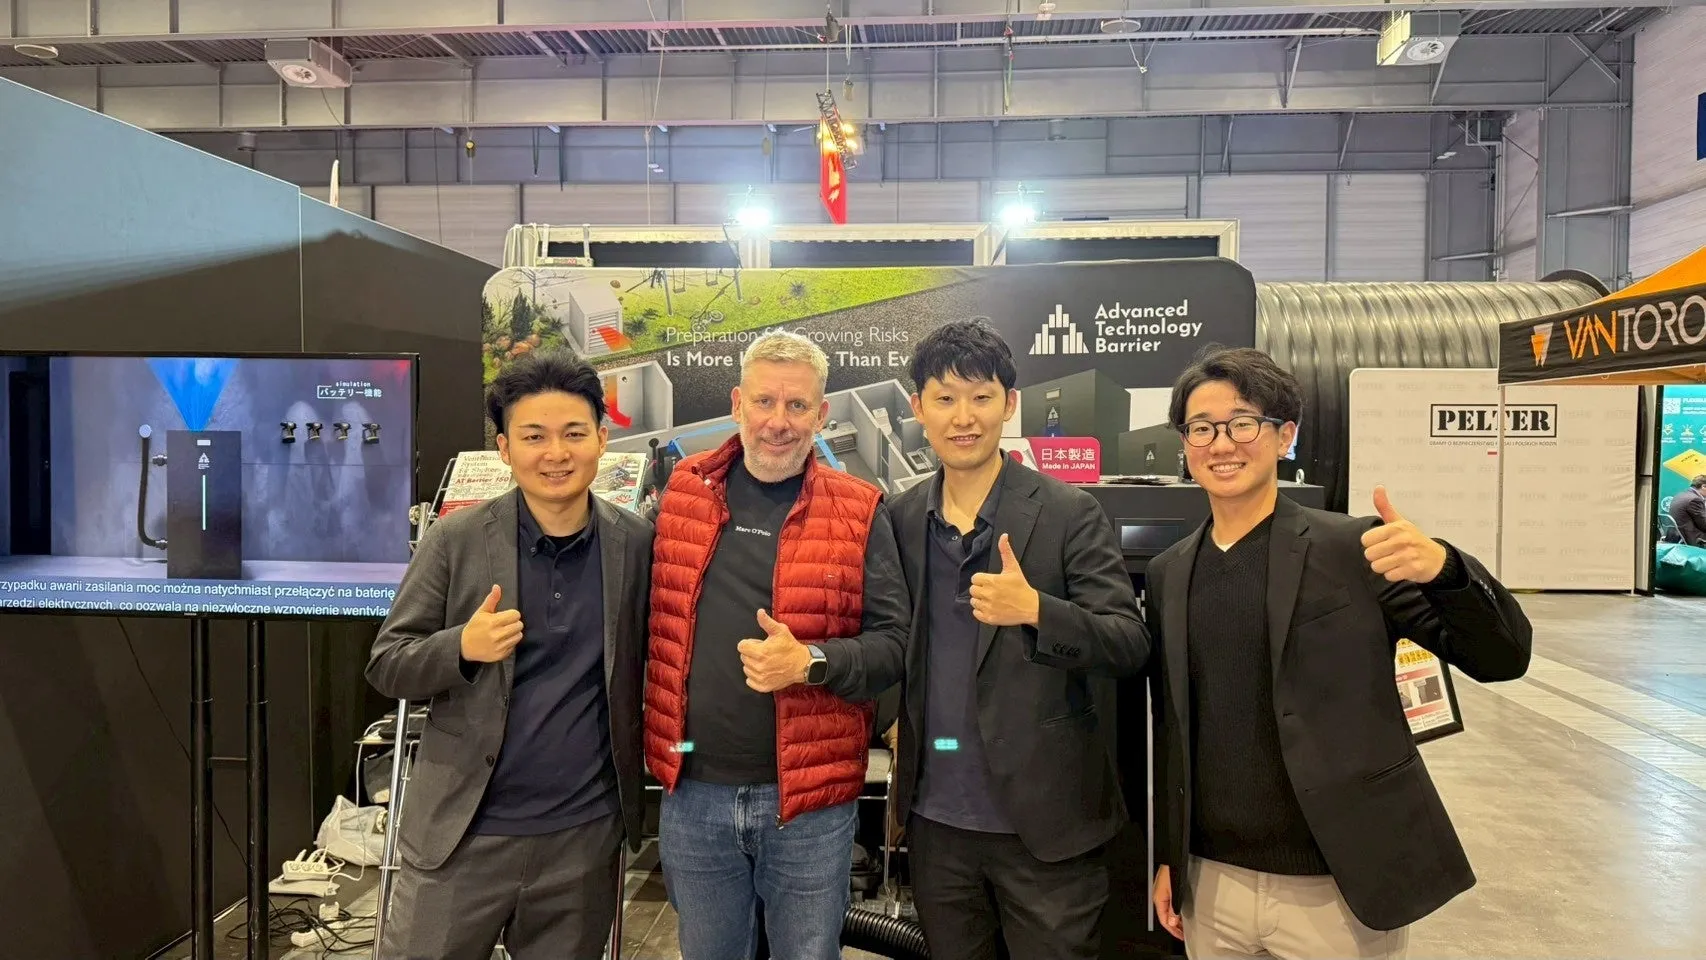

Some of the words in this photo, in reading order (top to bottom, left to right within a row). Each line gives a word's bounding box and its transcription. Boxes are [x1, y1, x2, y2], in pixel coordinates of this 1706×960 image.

[1095, 299, 1188, 319] Advanced
[665, 327, 757, 346] Preparation
[869, 327, 909, 343] Risks
[1095, 317, 1202, 337] Technology
[1563, 295, 1706, 359] VANTORO
[1096, 338, 1161, 353] Barrier
[667, 351, 680, 366] Is
[686, 351, 733, 366] More
[836, 351, 882, 366] Than
[888, 351, 910, 366] Ev
[1041, 448, 1096, 461] 日本製造
[50, 580, 82, 592] awarii
[85, 582, 134, 593] zasilania
[136, 584, 161, 593] moc
[163, 583, 201, 594] można
[204, 584, 272, 597] natychmiast
[274, 586, 335, 599] przełączyć
[338, 588, 352, 597] na
[356, 586, 396, 600] baterię
[120, 602, 133, 611] co
[184, 603, 199, 612] na
[202, 602, 271, 614] niezwłoczne
[273, 604, 339, 615] wznowienie
